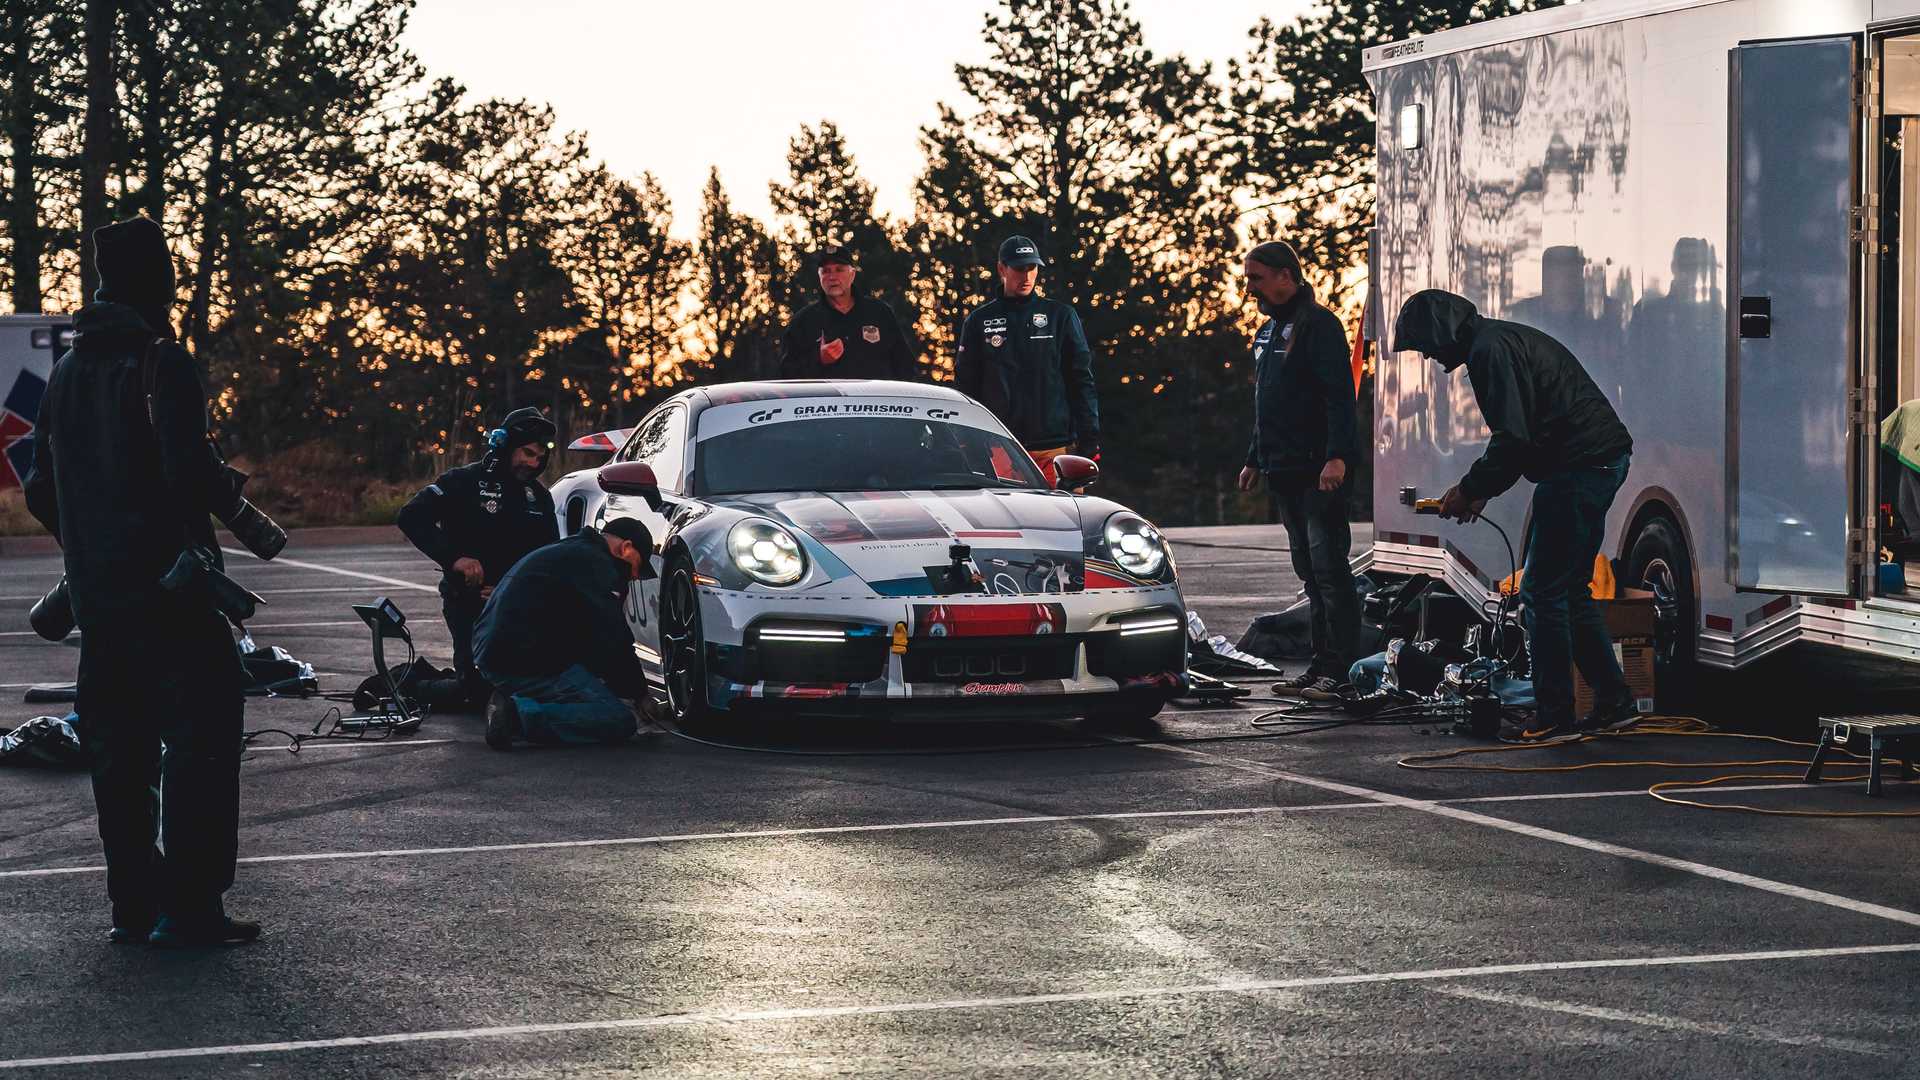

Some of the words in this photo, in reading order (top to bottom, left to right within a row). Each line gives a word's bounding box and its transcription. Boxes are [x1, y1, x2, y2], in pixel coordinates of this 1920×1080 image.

[1394, 41, 1424, 57] FEATHERLITE
[793, 404, 838, 415] GRAN
[843, 404, 914, 414] TURISMO
